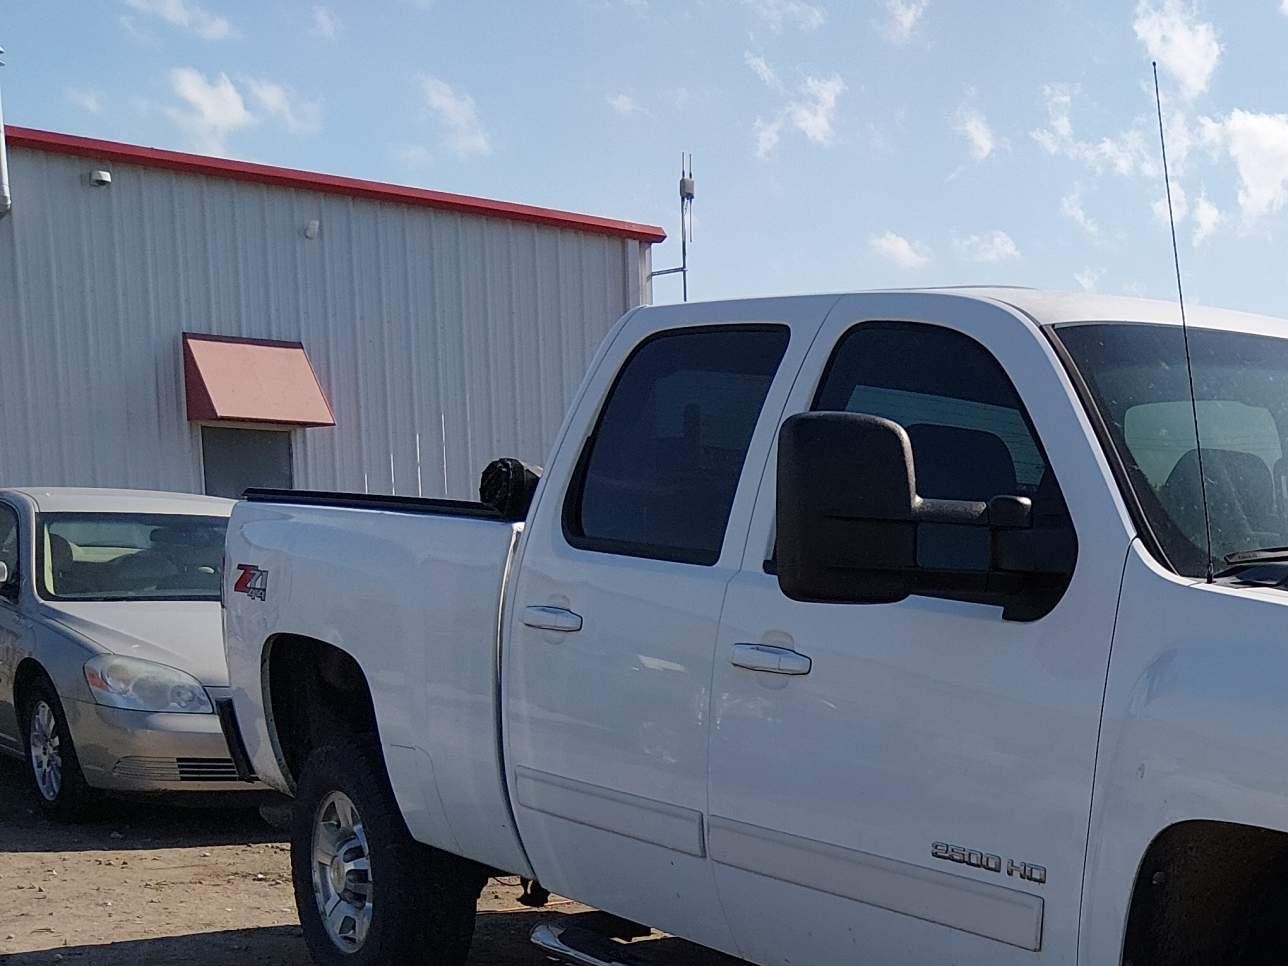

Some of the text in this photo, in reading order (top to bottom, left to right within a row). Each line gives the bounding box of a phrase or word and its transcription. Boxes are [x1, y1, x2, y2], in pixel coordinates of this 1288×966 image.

[234, 564, 269, 593] Z71
[931, 841, 1047, 884] 2500 HD
